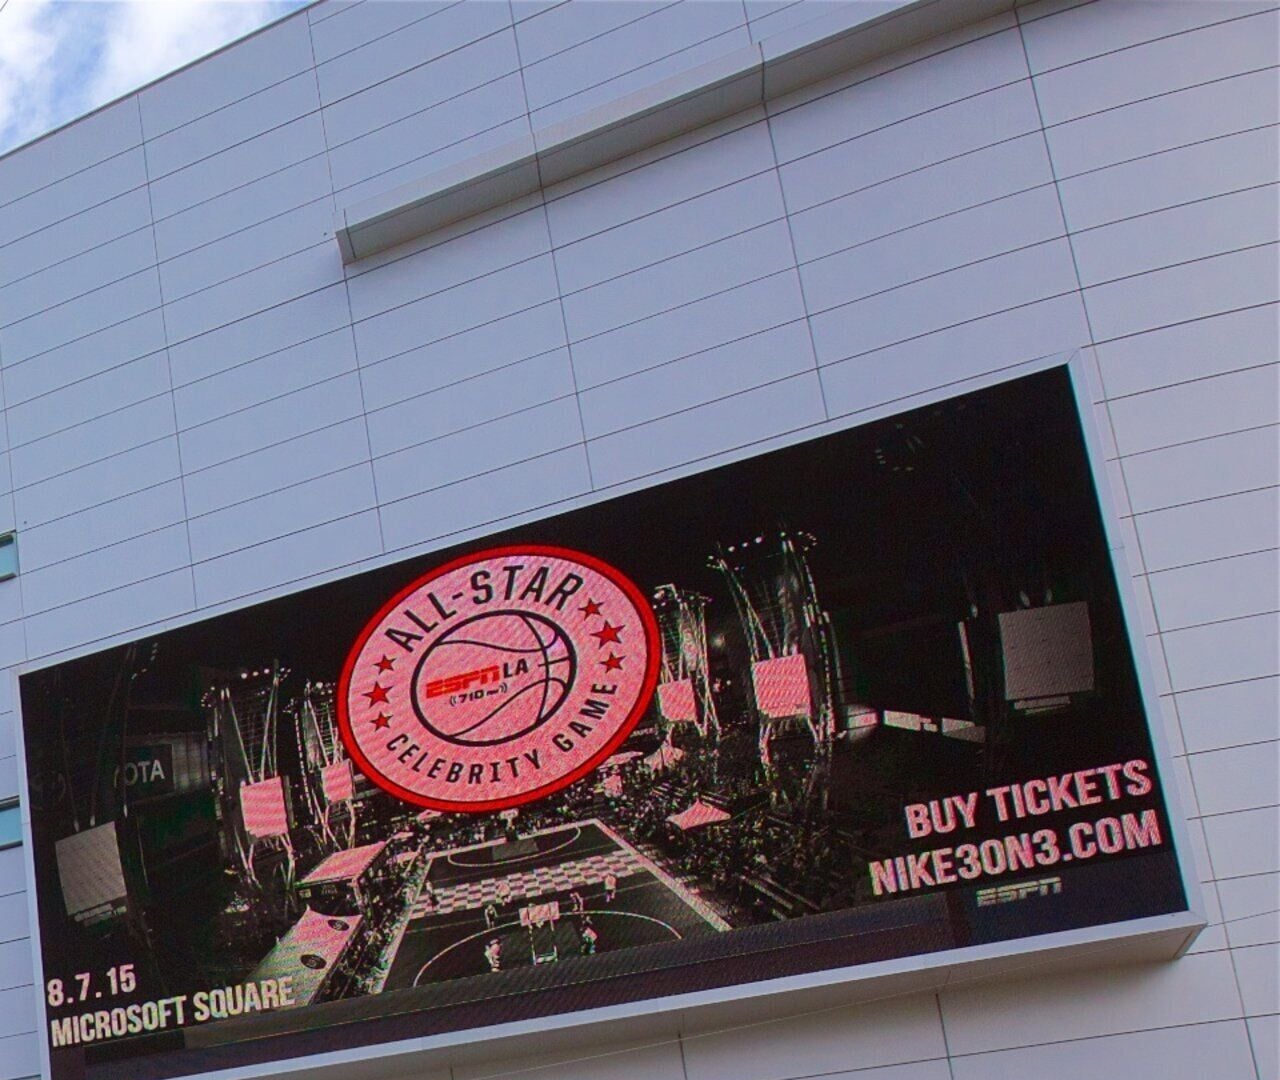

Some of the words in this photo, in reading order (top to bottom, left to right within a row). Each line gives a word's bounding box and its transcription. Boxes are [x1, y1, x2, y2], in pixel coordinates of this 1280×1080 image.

[385, 565, 584, 653] ALL-STAR
[386, 733, 541, 785] CELEBRITY
[551, 682, 618, 753] GAME
[904, 794, 982, 840] BUY
[986, 759, 1153, 821] TICKETS
[868, 808, 1162, 895] NIKE3ON3.COM
[976, 876, 1062, 907] ESPN
[47, 964, 137, 1007] 8.7.15
[51, 998, 185, 1048] MICROSOFT
[192, 976, 295, 1022] SQUARE
